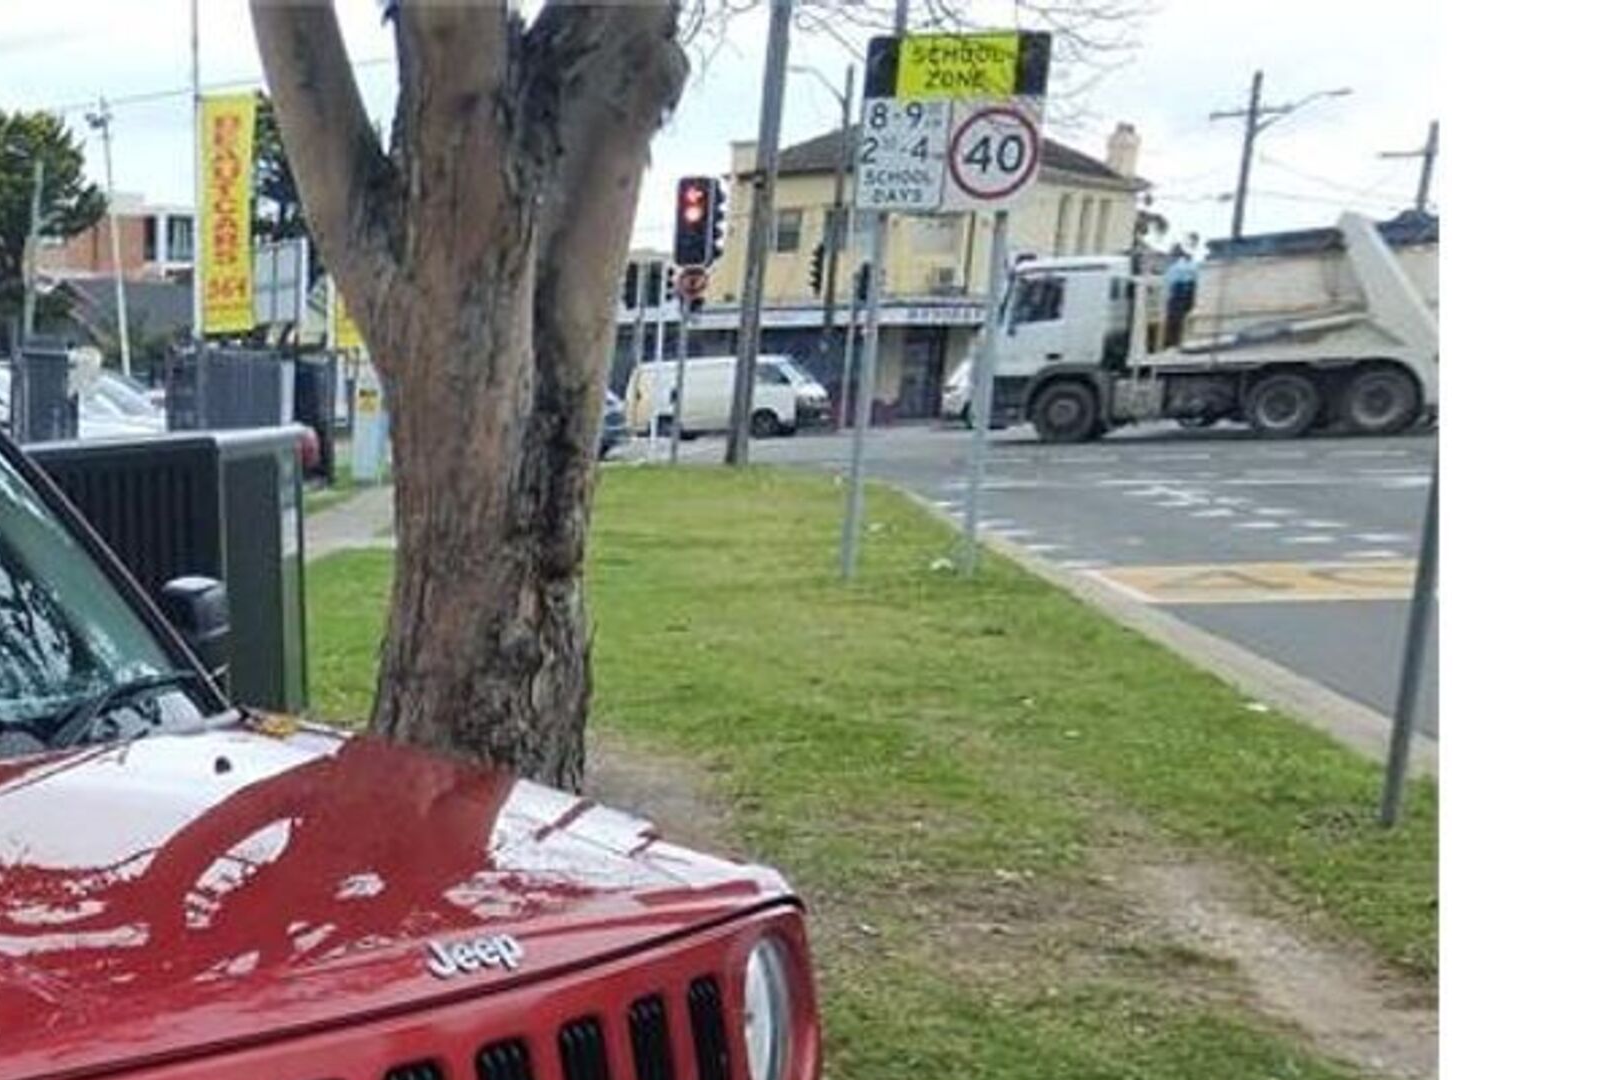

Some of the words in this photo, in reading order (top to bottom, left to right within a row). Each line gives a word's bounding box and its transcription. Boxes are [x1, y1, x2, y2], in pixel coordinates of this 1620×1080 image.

[910, 45, 1006, 64] SCHOOL
[924, 69, 986, 88] ZONE
[963, 133, 1026, 174] 40
[863, 169, 931, 187] SCHOOL
[873, 189, 923, 203] DAYS
[425, 934, 523, 976] Jeep
